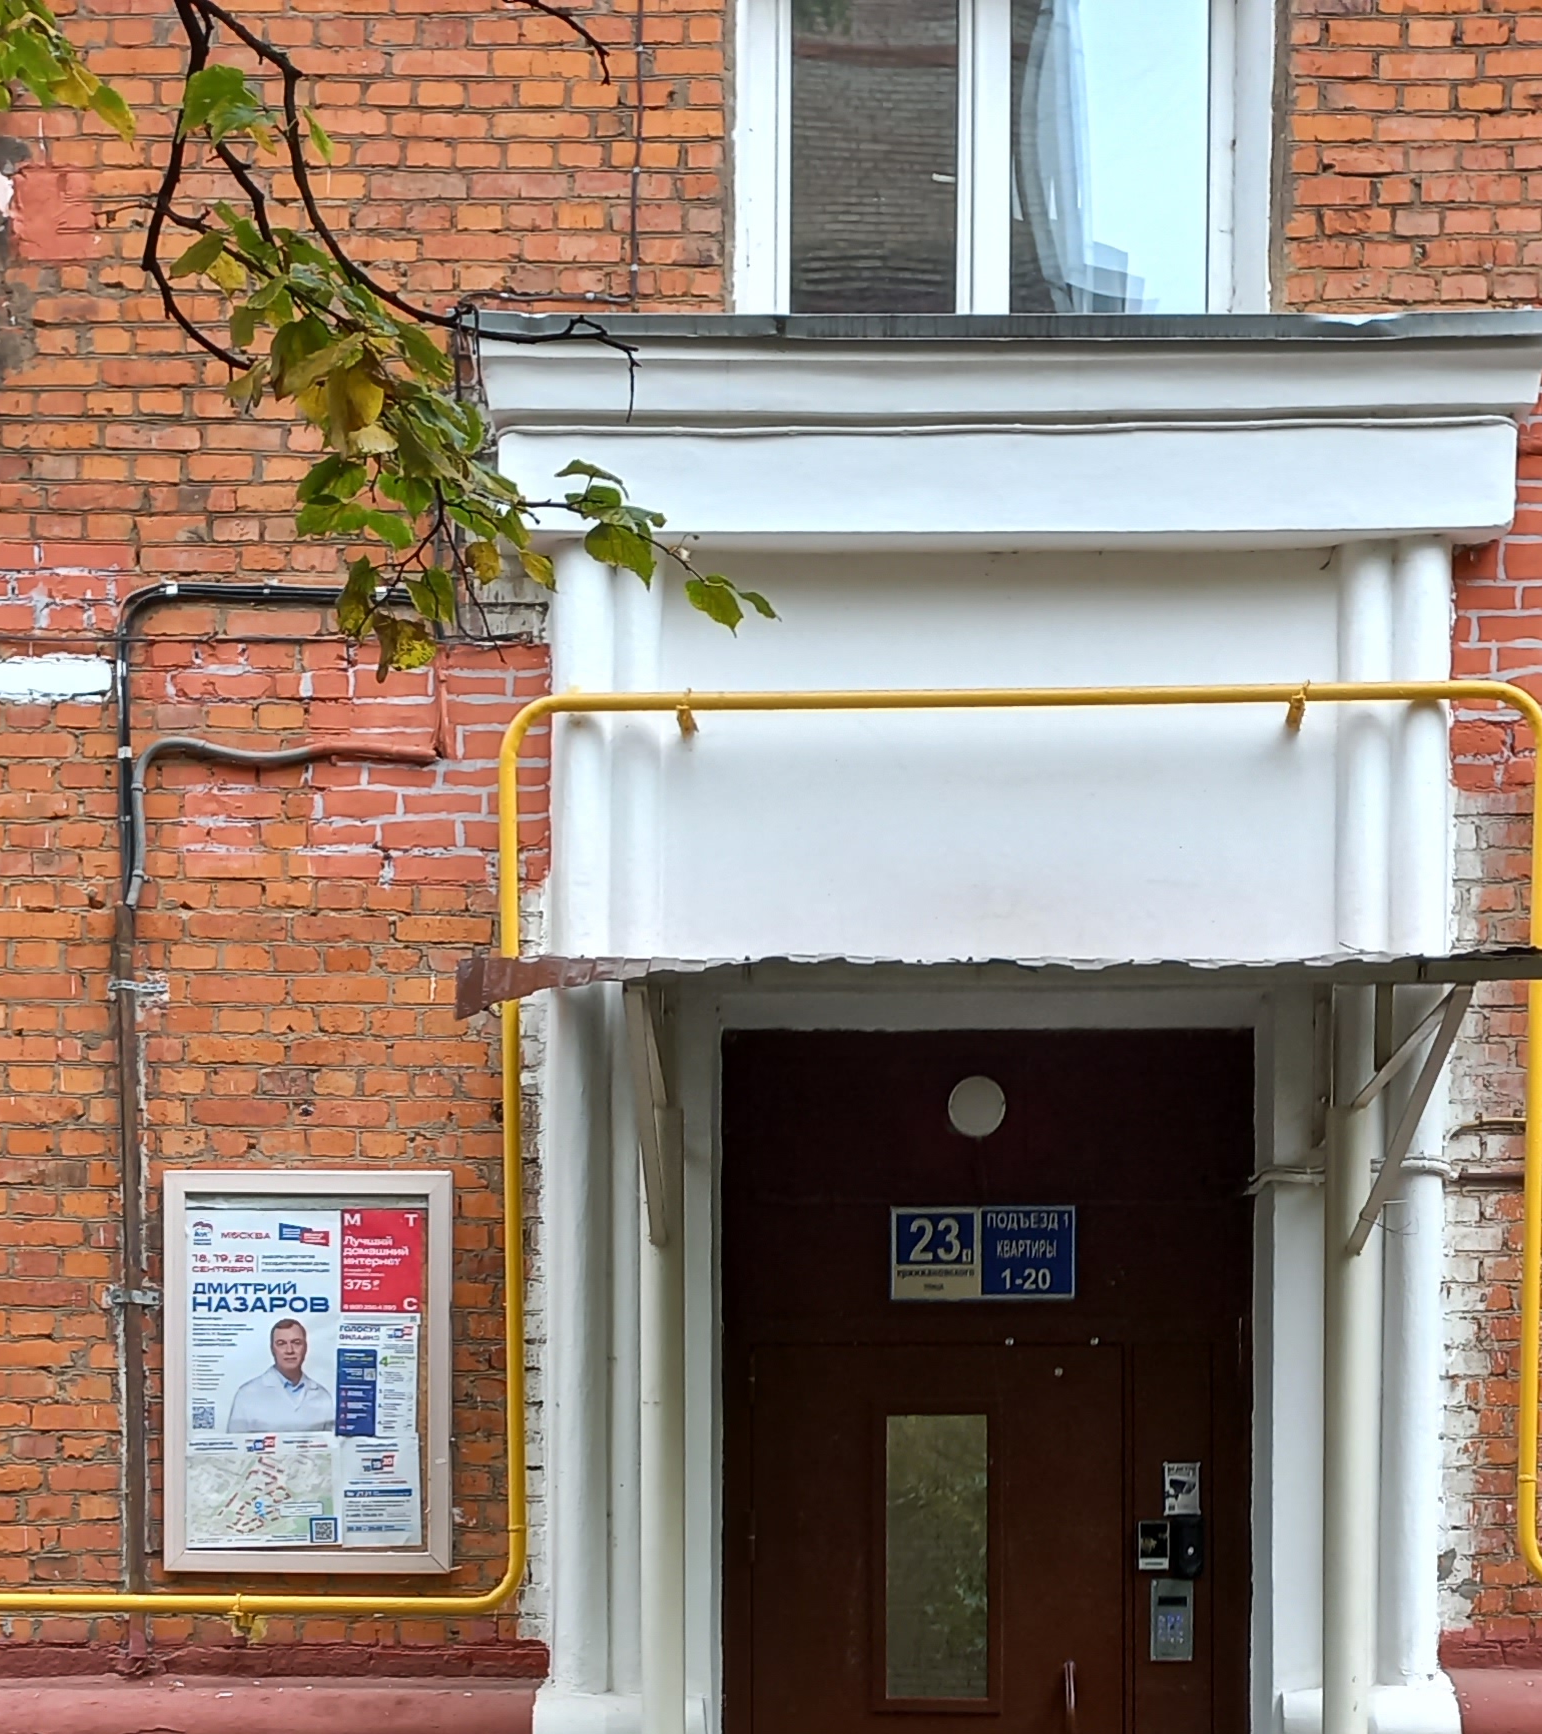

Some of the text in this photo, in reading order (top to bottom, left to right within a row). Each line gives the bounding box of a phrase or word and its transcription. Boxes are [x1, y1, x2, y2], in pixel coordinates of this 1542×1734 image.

[343, 1213, 419, 1227] М Т
[986, 1212, 1069, 1231] ПОДЪЕЗД 1
[220, 1231, 271, 1240] МОСКВА
[909, 1217, 961, 1262] 23
[996, 1239, 1057, 1259] КВАРТИРЫ
[234, 1253, 255, 1263] 20
[192, 1265, 255, 1273] СЕНТЯБРЯ
[343, 1279, 372, 1290] 375
[1000, 1267, 1051, 1290] 1-20
[192, 1280, 297, 1295] ДМИТРИЙ
[192, 1296, 330, 1313] НАЗАРОВ
[402, 1297, 418, 1311] С
